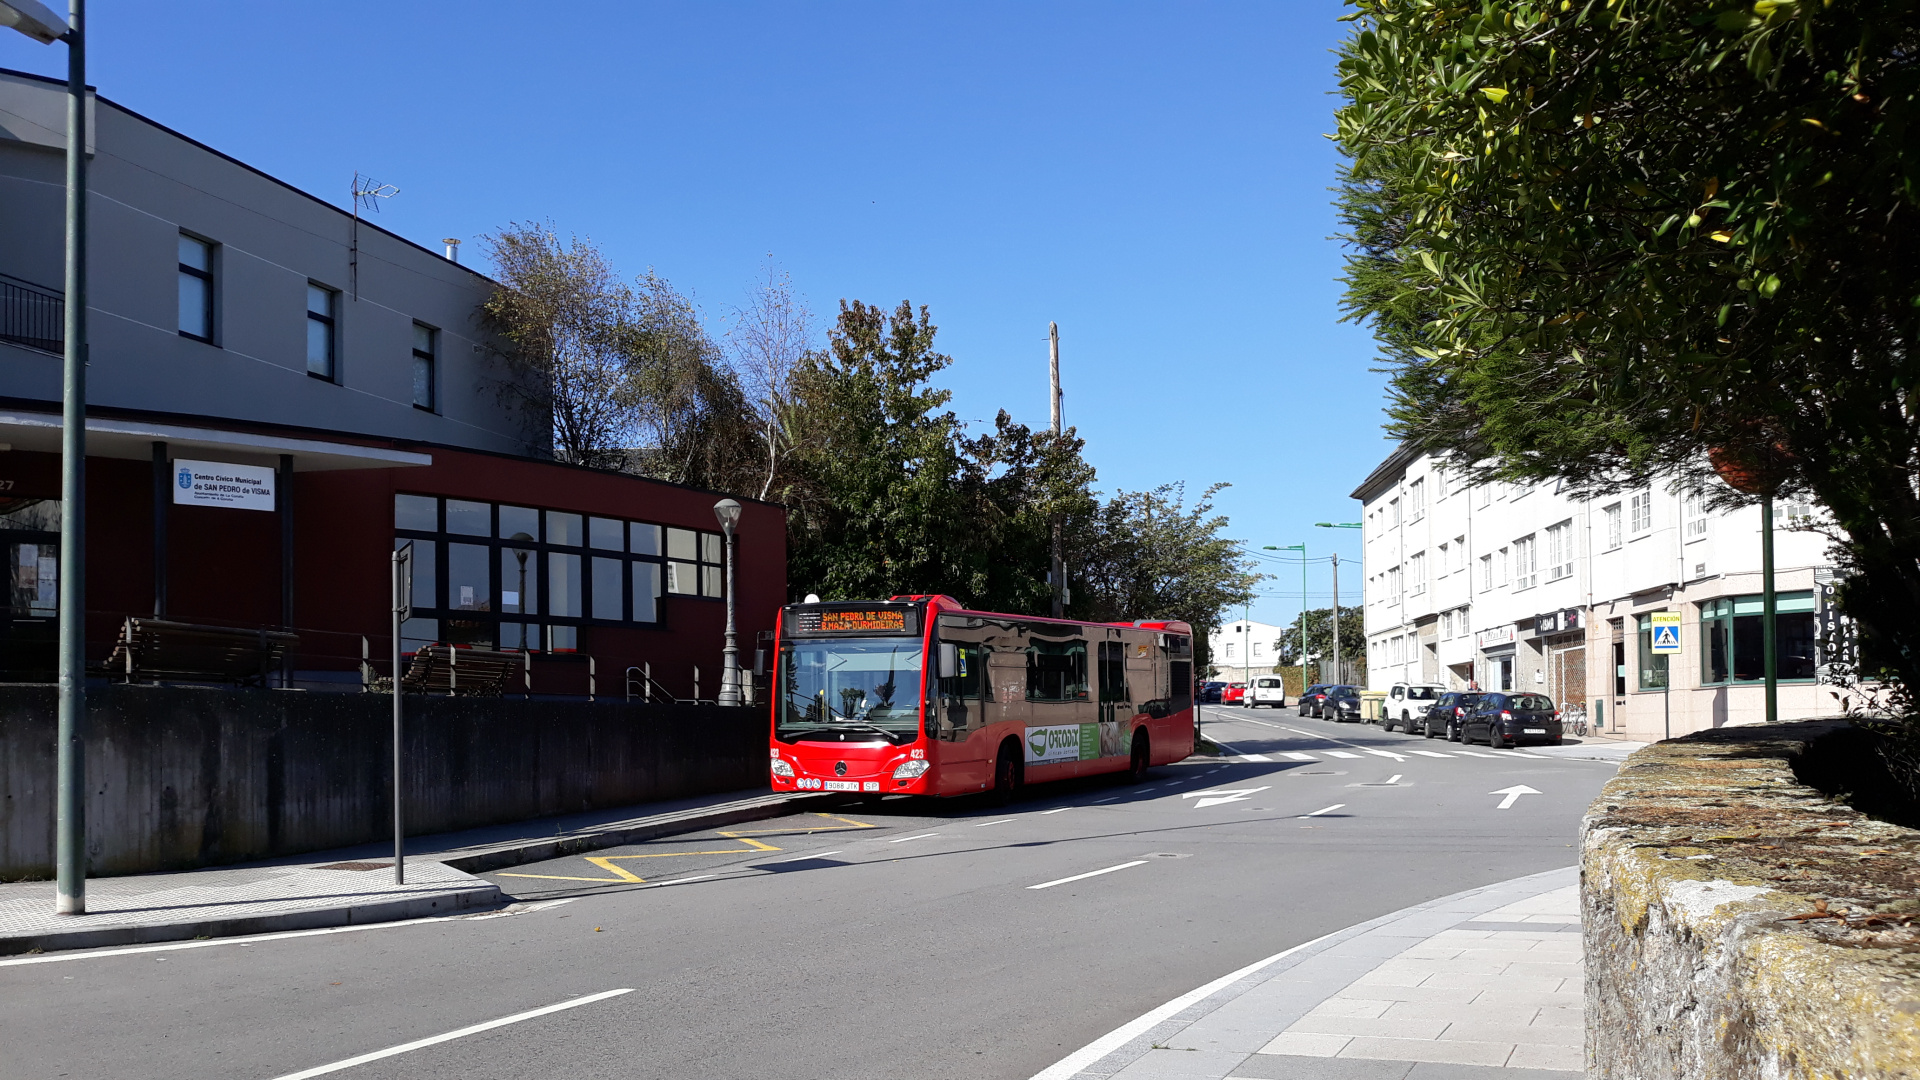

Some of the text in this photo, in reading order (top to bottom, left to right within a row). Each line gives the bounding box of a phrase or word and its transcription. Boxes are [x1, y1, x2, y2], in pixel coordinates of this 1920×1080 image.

[194, 473, 214, 481] Centro
[235, 477, 261, 486] Municipal
[203, 483, 218, 492] SAN
[219, 484, 241, 493] PEDRO
[242, 486, 250, 495] de
[251, 487, 270, 496] VISMA
[822, 611, 904, 621] SAN PEDRO DE VISMA
[910, 749, 924, 759] 423
[865, 782, 878, 790] SP
